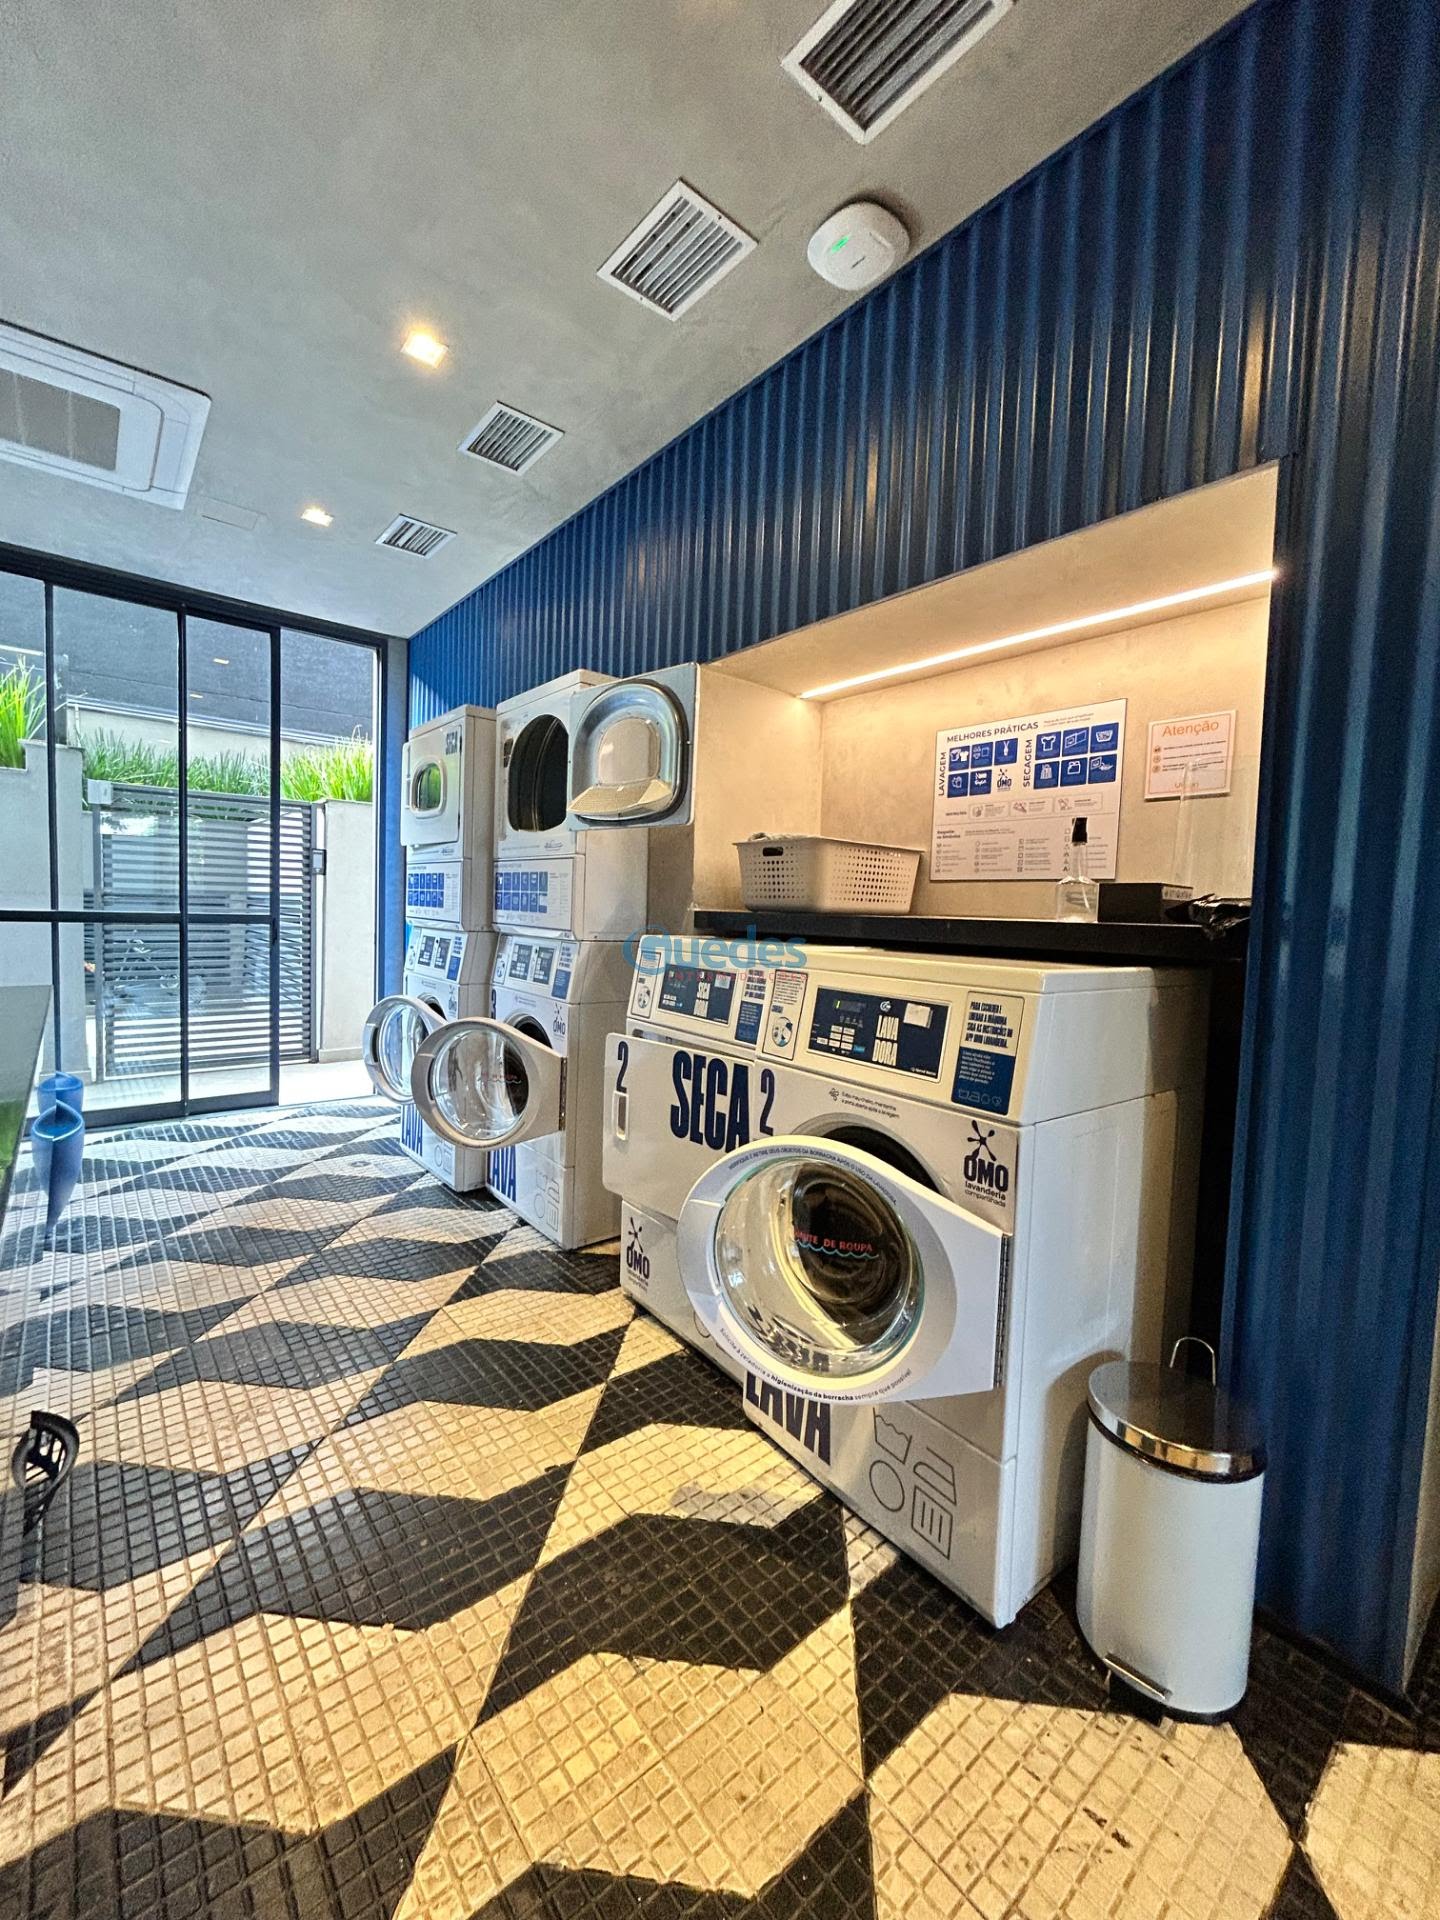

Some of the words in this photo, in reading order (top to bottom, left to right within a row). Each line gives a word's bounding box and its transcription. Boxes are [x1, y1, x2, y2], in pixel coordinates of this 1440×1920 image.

[947, 729, 993, 743] MELHORES
[994, 721, 1039, 736] PRÁTICAS
[1162, 721, 1219, 737] Atenção
[938, 751, 947, 797] LAVAGEM
[1023, 739, 1033, 788] SECAGEM
[996, 776, 1012, 788] OMO
[552, 1018, 566, 1036] OMO
[876, 1015, 899, 1041] LAVA
[616, 1041, 629, 1093] 2
[872, 1039, 898, 1066] DORA
[670, 1050, 750, 1153] SECA
[760, 1068, 775, 1136] 2
[401, 1104, 423, 1157] LAVA
[809, 1149, 836, 1161] BORRACHA
[963, 1154, 1009, 1192] OMO
[964, 1181, 1006, 1201] lavanderia
[823, 1239, 836, 1248] DE
[839, 1241, 873, 1252] ROUPA
[626, 1245, 650, 1279] OMO
[741, 1352, 766, 1376] zeladoria
[770, 1375, 813, 1397] higienização
[813, 1391, 822, 1399] da
[854, 1389, 878, 1401] sempre
[879, 1384, 891, 1396] que
[890, 1368, 912, 1389] possível
